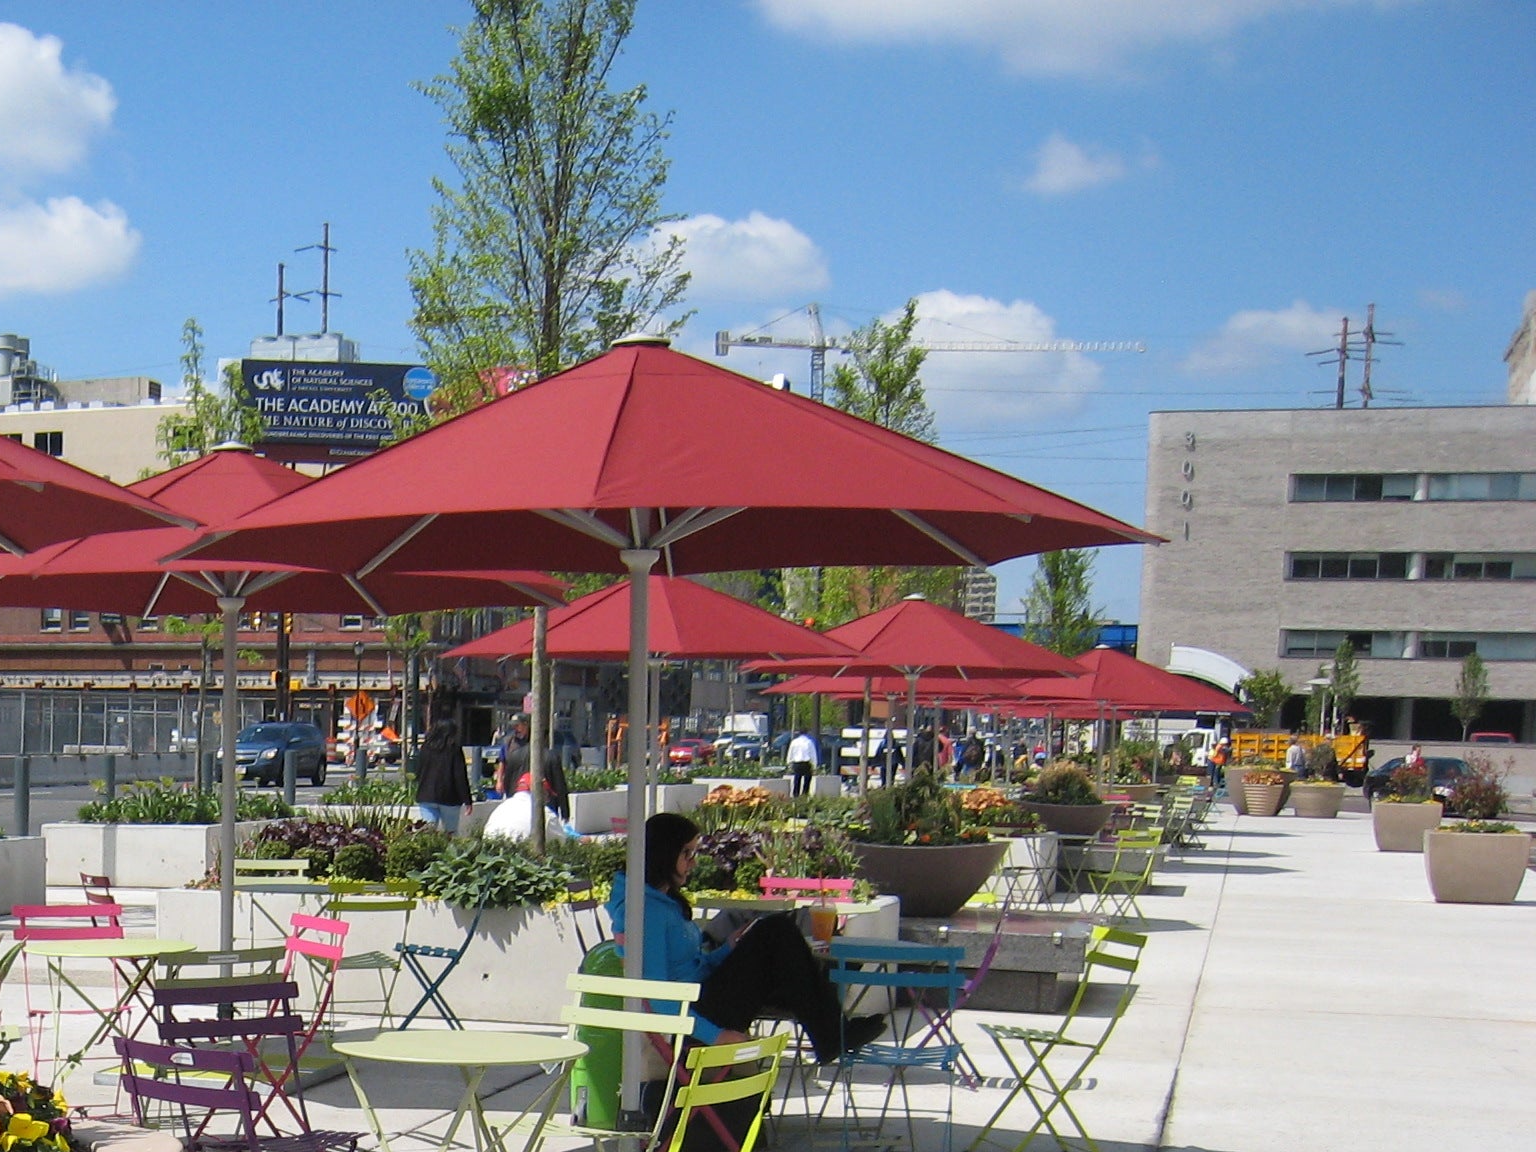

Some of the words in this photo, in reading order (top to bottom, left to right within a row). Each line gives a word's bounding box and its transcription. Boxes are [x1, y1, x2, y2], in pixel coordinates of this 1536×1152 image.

[255, 397, 284, 412] THE
[288, 398, 364, 415] ACADEMY
[284, 415, 333, 428] NATURE
[336, 417, 347, 430] of
